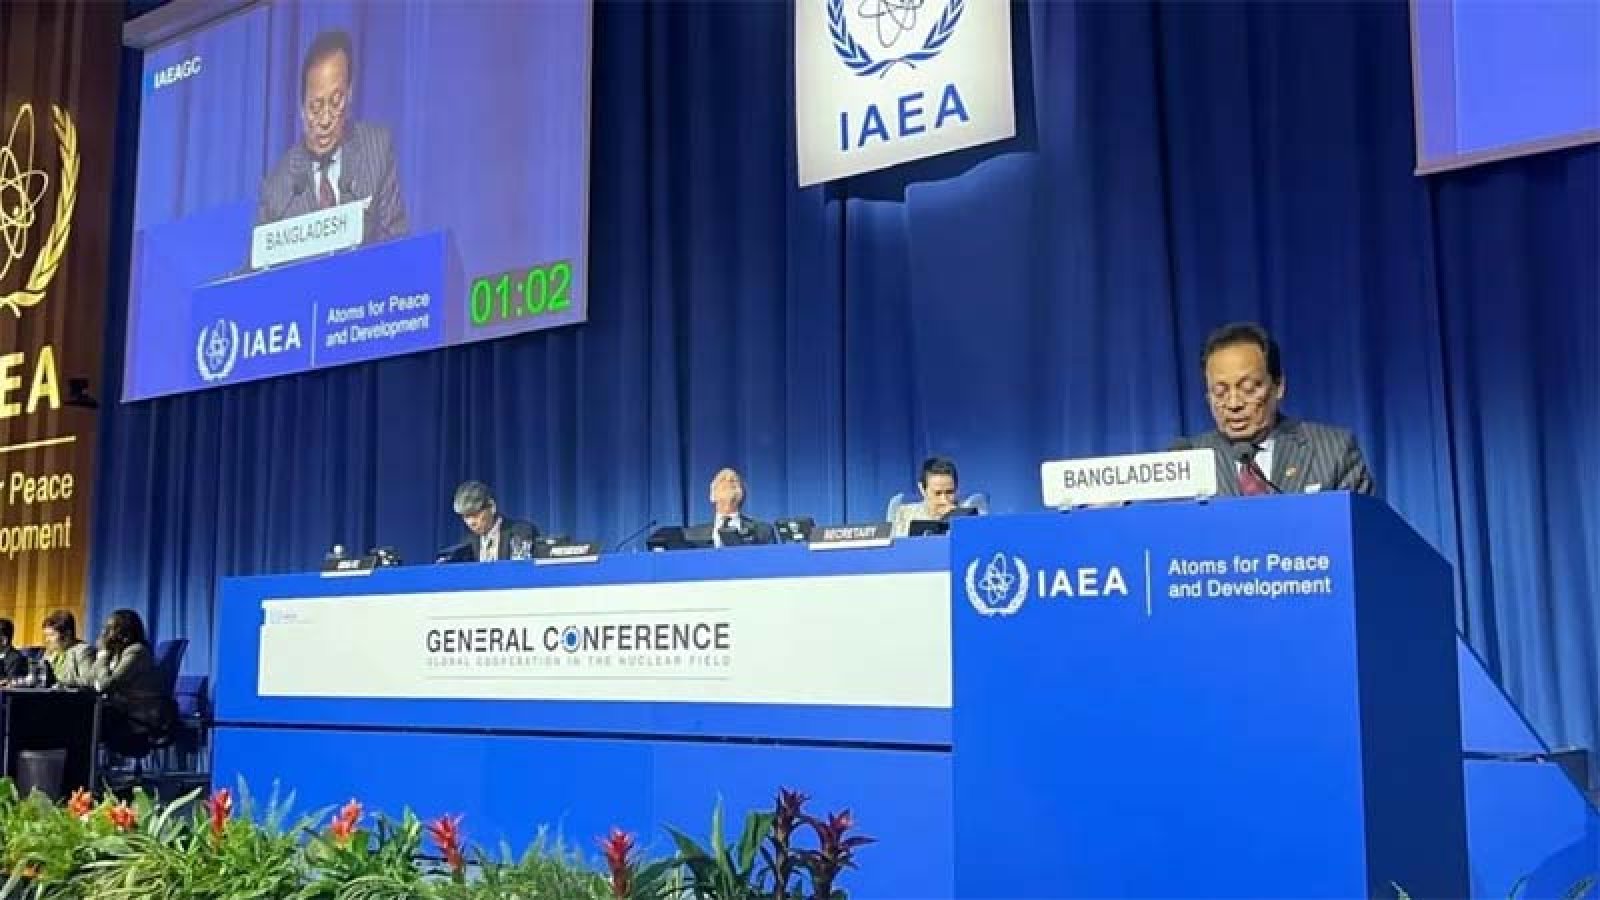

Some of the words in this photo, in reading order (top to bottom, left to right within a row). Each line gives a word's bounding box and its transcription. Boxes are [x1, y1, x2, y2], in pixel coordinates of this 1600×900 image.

[840, 84, 970, 151] IAEA
[265, 214, 347, 251] BANGLADESH
[327, 303, 365, 325] Atoms
[367, 299, 386, 318] for
[388, 291, 431, 313] Peace
[470, 263, 573, 326] 01:02
[243, 321, 302, 358] IAEA
[326, 328, 348, 348] and
[349, 313, 430, 346] Development
[10, 471, 73, 505] Peace
[1063, 461, 1191, 489] BANGLADESH
[1168, 558, 1227, 575] Atoms
[1232, 555, 1259, 574] for
[1266, 553, 1331, 572] Peace
[1038, 567, 1129, 598] IAEA
[1168, 580, 1201, 599] and
[1207, 577, 1332, 598] Development
[426, 627, 534, 653] GENERAL
[543, 622, 731, 653] CONFERENCE
